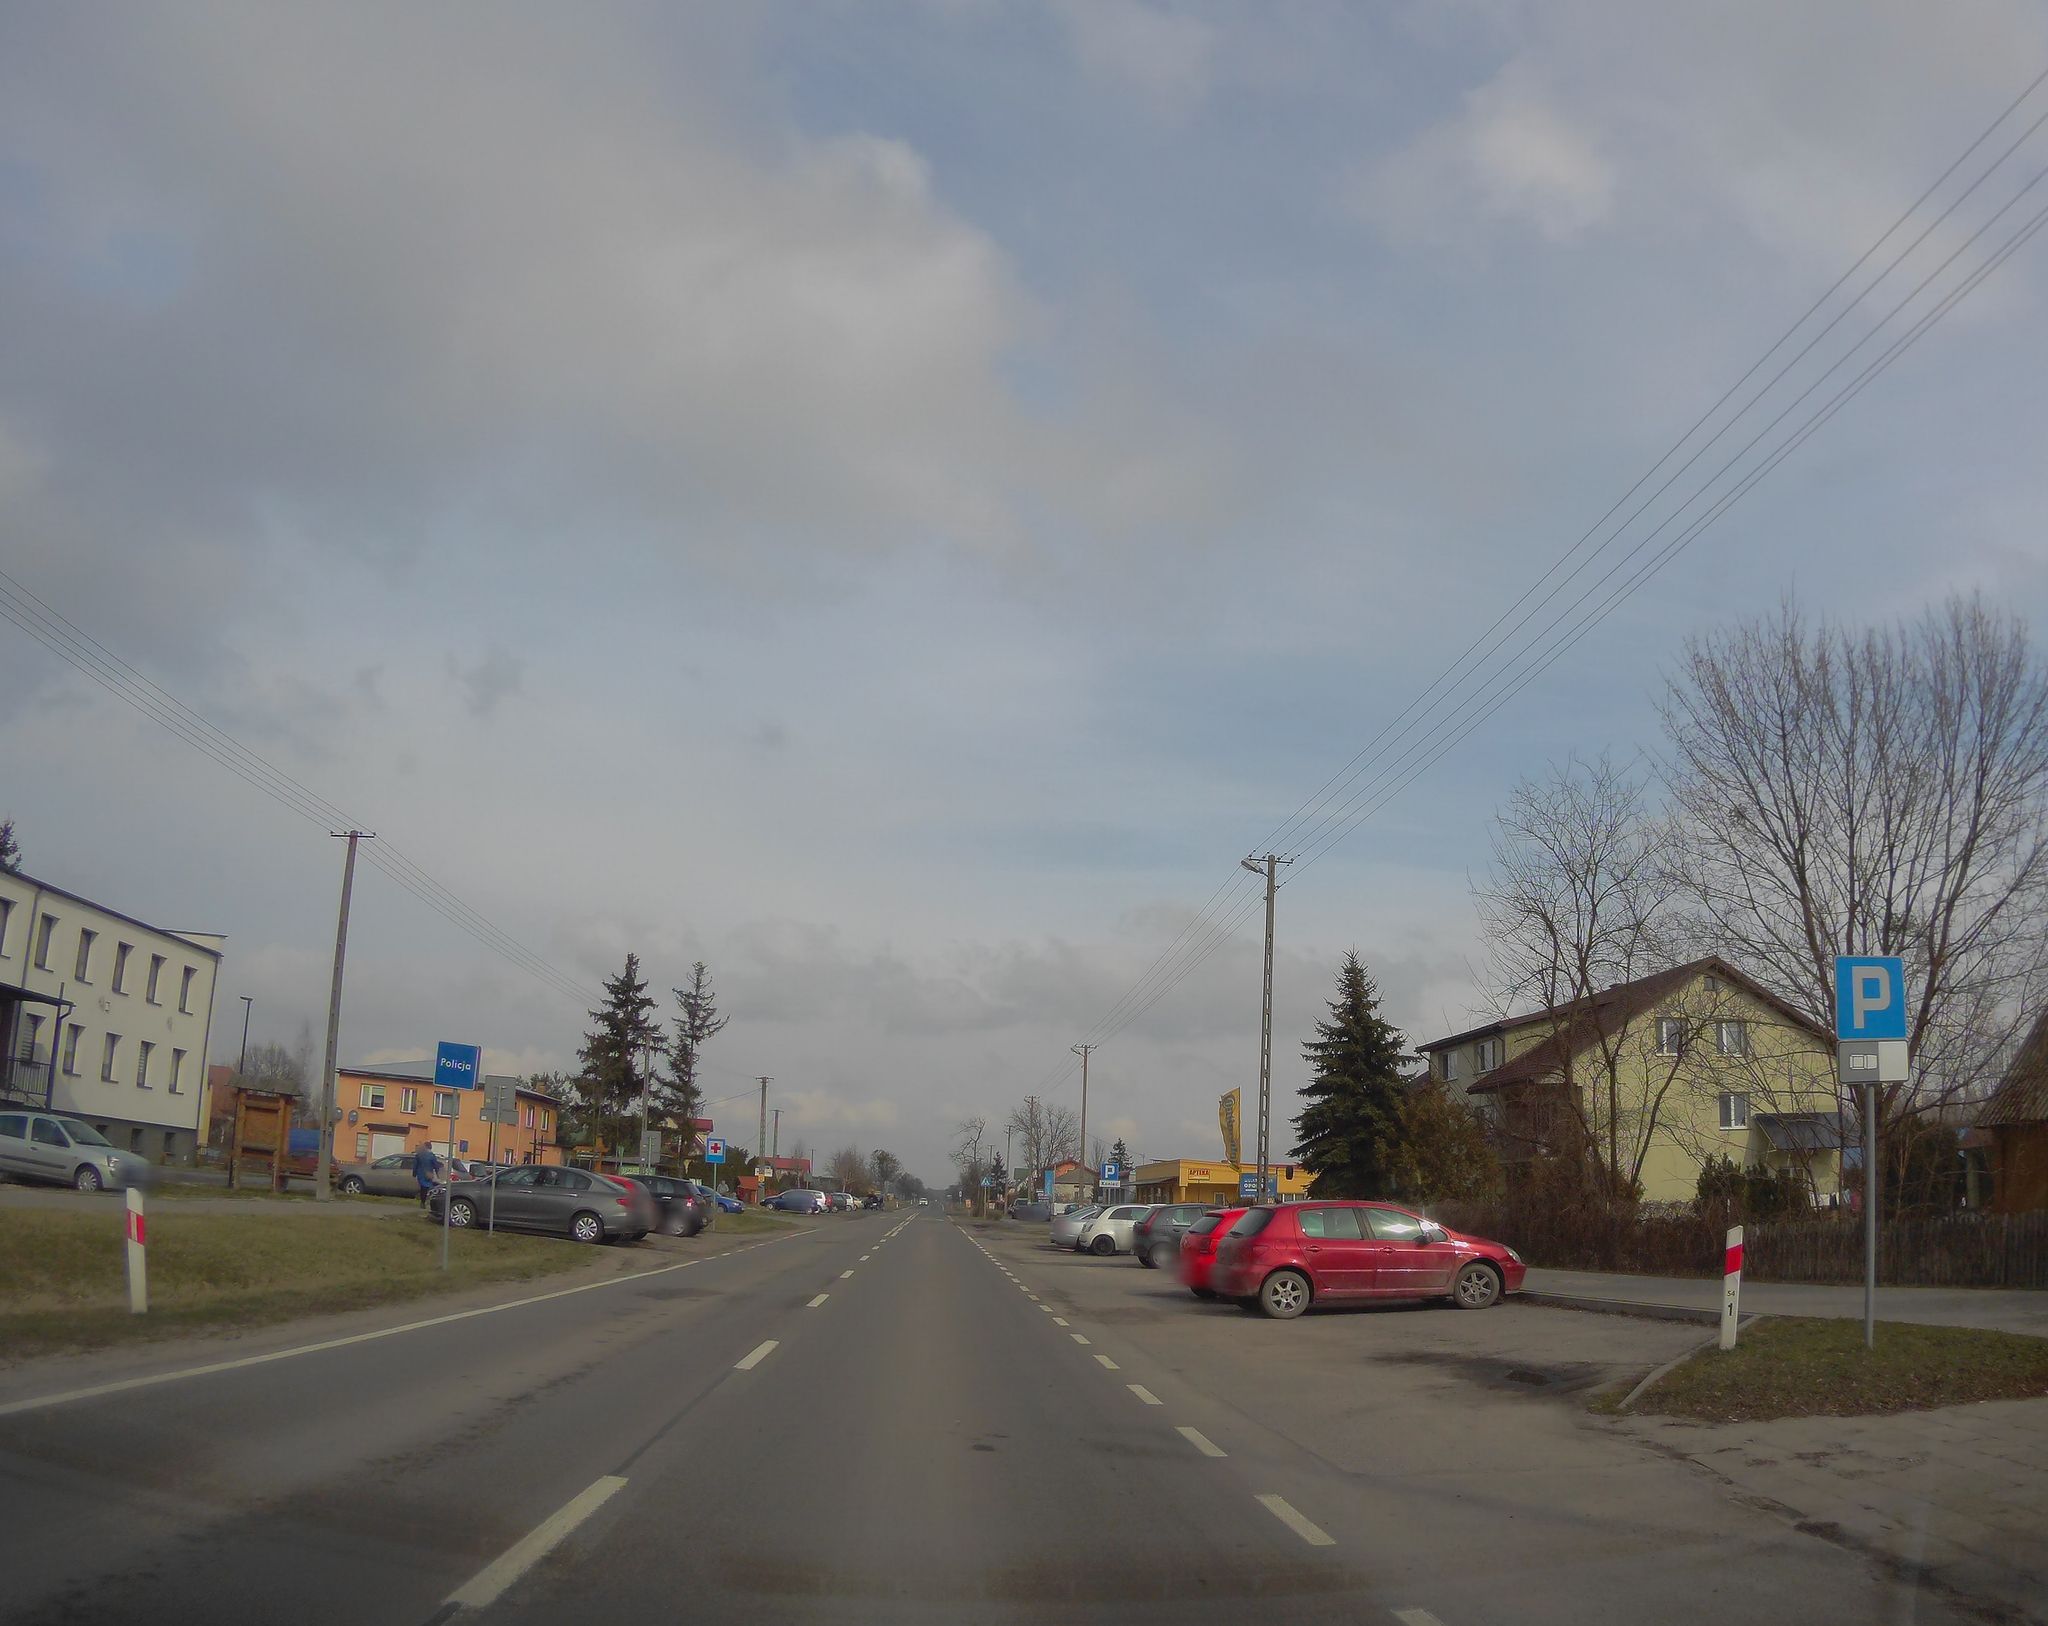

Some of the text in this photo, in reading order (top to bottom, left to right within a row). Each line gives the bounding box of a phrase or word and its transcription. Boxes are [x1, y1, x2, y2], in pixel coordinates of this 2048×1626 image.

[1851, 965, 1890, 1029] P
[440, 1058, 471, 1071] Policja
[1105, 1165, 1115, 1178] P
[1727, 1302, 1733, 1317] 1
